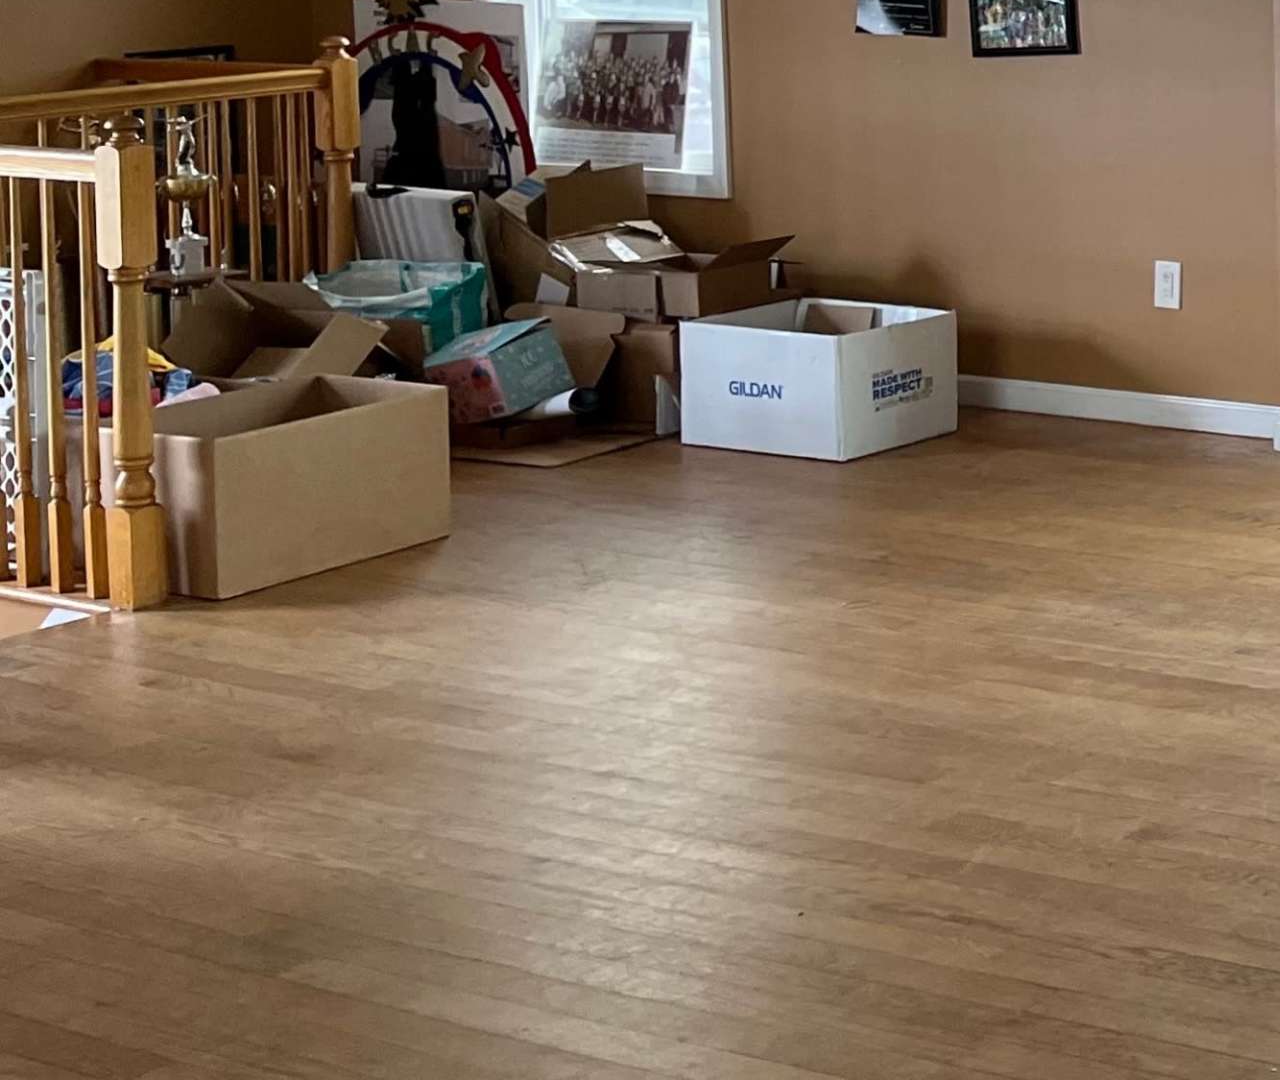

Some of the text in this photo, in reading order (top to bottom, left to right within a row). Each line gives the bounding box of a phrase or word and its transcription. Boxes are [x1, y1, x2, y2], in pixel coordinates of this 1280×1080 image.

[872, 367, 923, 389] MADE WITH
[872, 377, 923, 401] RESPECT
[729, 380, 782, 399] GILDAN
